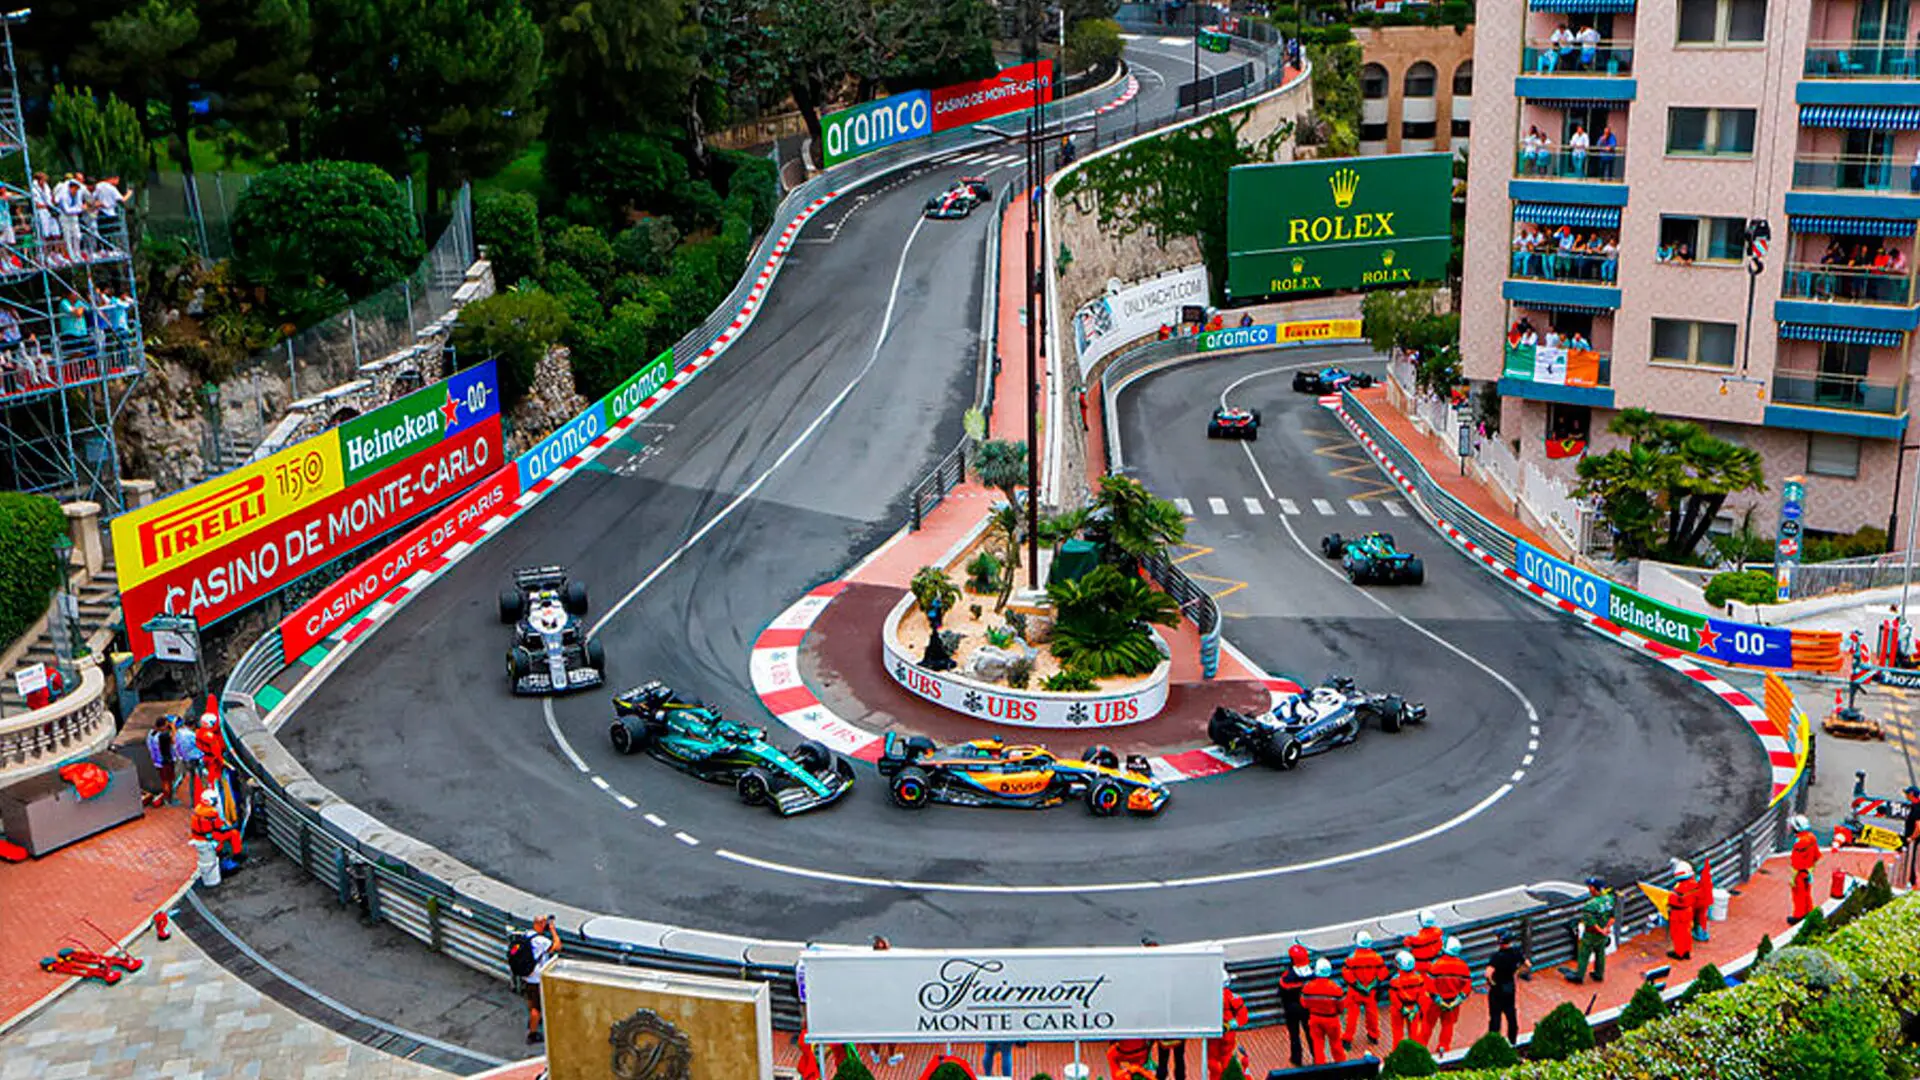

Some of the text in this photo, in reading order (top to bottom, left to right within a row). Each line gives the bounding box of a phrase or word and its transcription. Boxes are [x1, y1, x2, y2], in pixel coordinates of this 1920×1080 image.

[827, 98, 928, 157] aramco
[1288, 212, 1395, 244] ROLEX
[1270, 276, 1323, 292] ROLEX
[1362, 268, 1412, 284] ROLEX
[1206, 328, 1269, 349] aramco
[612, 361, 667, 418] aramco
[346, 408, 440, 471] Heineken
[529, 413, 598, 480] aramco
[138, 451, 324, 568] PIRELLI 150
[164, 436, 489, 617] CASINO DE MONTE-CARLO
[305, 485, 505, 637] CASINO CAFE DE PARIS
[1524, 551, 1597, 608] aramco
[1609, 593, 1691, 642] Heineken
[906, 669, 943, 700] UBS
[987, 696, 1038, 721] UBS
[1094, 698, 1139, 724] UBS
[918, 957, 1112, 1014] Fairmont
[917, 1011, 1115, 1032] MONTE CARLO
